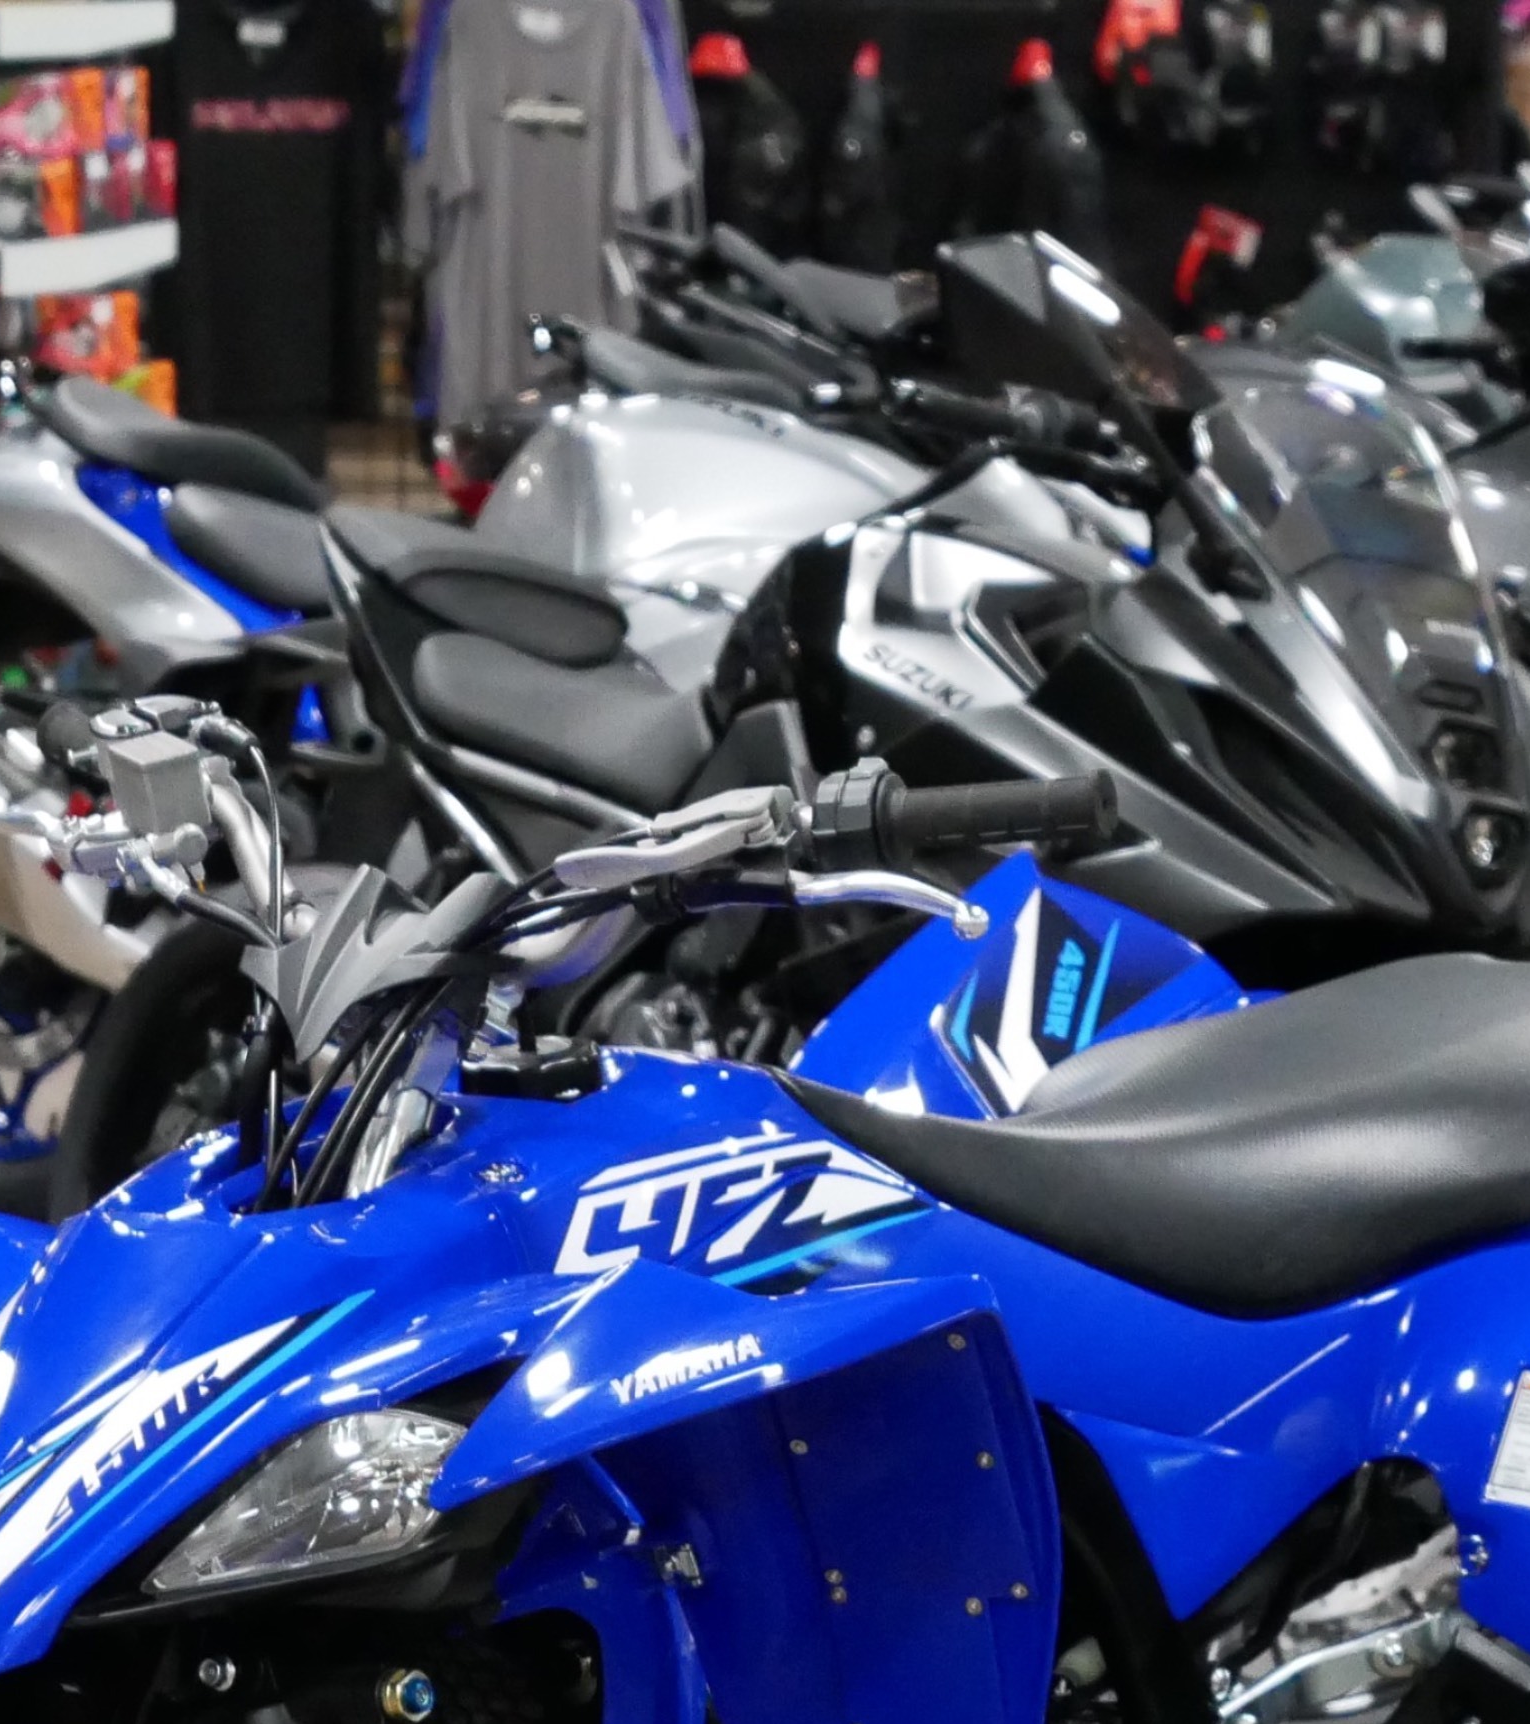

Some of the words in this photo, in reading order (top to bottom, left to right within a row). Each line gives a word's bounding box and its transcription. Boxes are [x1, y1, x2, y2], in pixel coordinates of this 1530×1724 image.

[863, 643, 975, 711] SUZUKI
[1043, 937, 1086, 1040] 450R
[610, 1332, 764, 1404] YAMAHA
